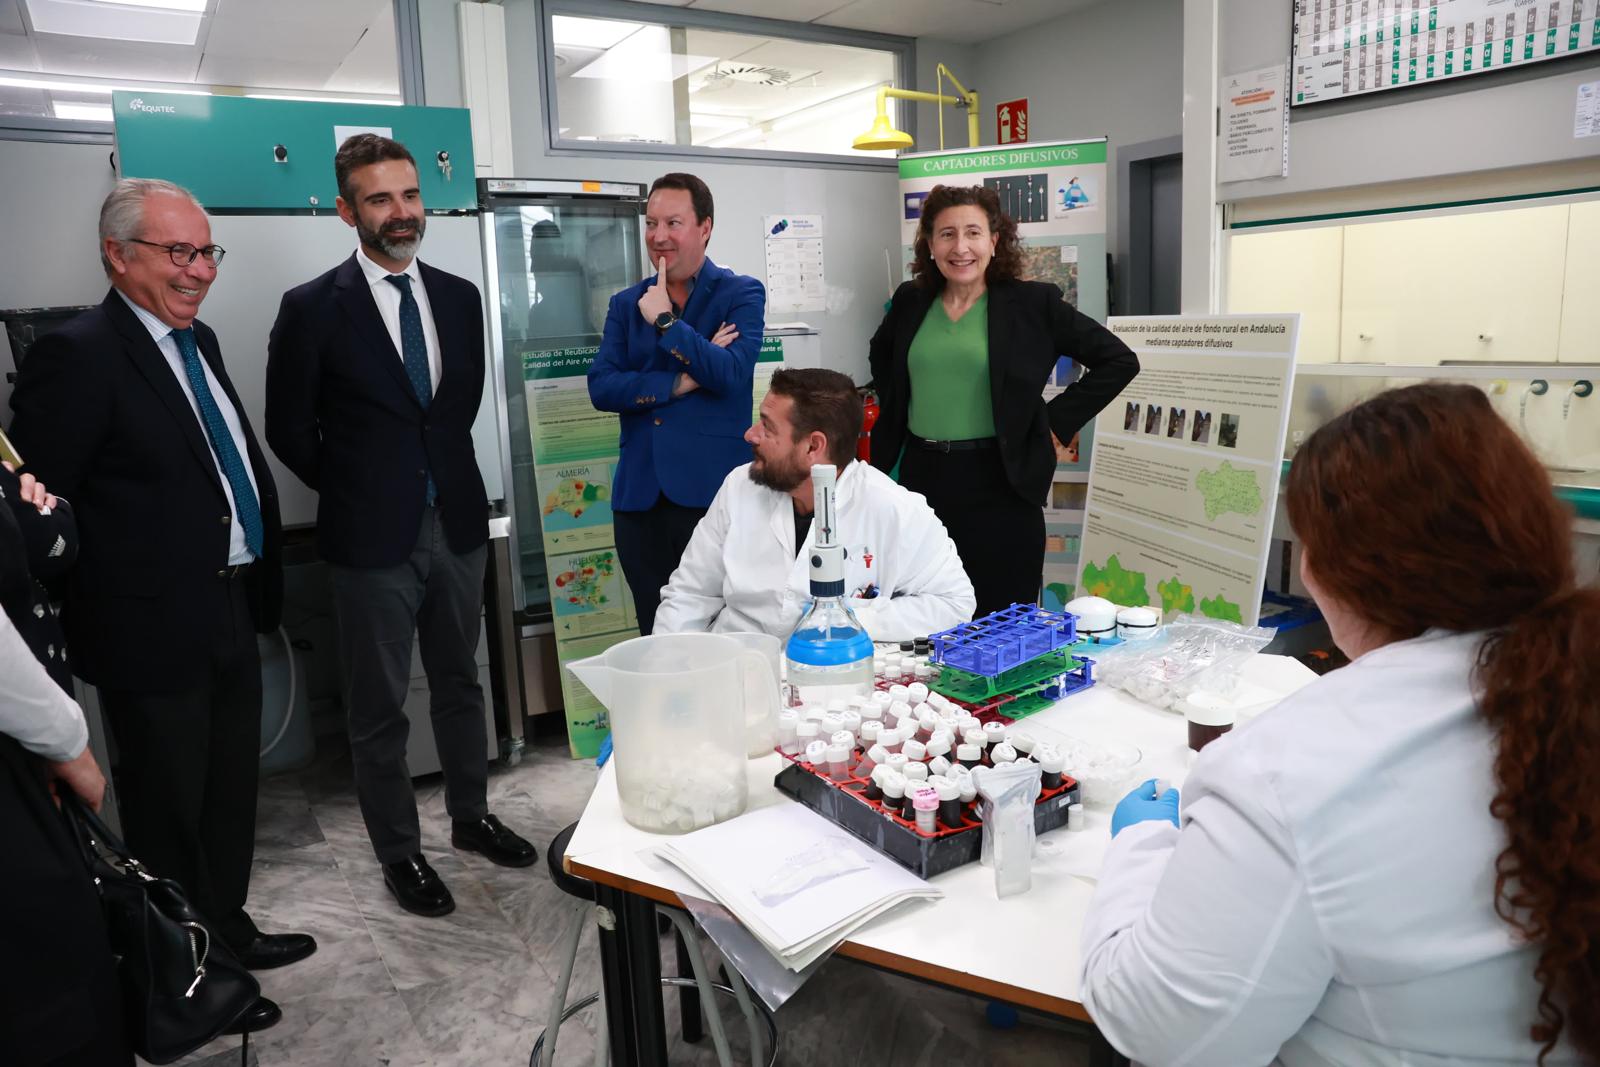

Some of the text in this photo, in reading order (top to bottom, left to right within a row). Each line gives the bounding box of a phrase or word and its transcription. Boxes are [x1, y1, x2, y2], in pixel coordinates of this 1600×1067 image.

[142, 105, 175, 113] EQUITEC
[923, 148, 1079, 173] CAPTADORES DIFUSIVOS
[1113, 323, 1286, 335] Evaluación de la calidad del aire de fondo rural en Andalucía
[1145, 338, 1233, 348] mediante captadores difusivos
[523, 350, 551, 360] Estudio
[554, 349, 562, 358] de
[523, 360, 551, 369] Calidad
[553, 359, 564, 368] del
[566, 358, 580, 366] Aire
